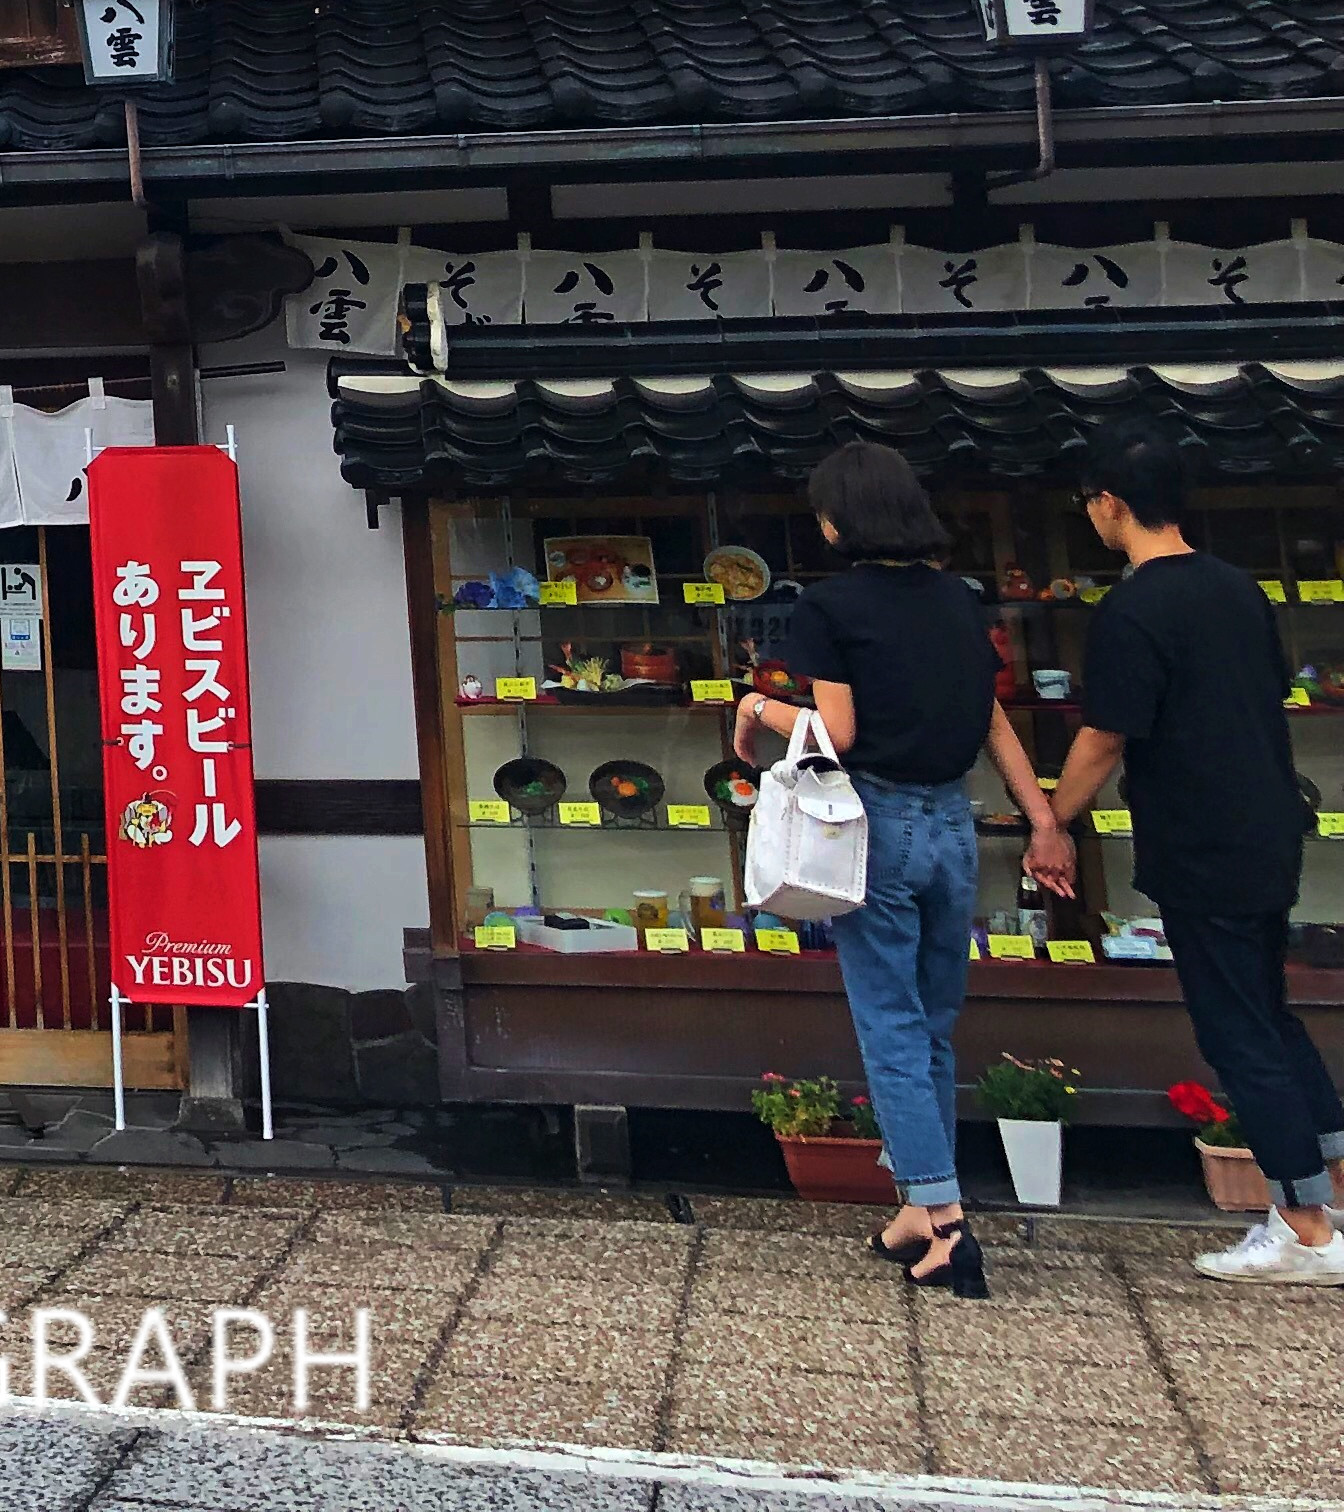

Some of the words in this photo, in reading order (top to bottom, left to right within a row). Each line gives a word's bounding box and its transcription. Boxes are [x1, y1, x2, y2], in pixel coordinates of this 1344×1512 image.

[309, 249, 370, 345] 八雲
[112, 560, 169, 781] あります。
[124, 955, 253, 988] YEBISU
[141, 931, 233, 955] Premium
